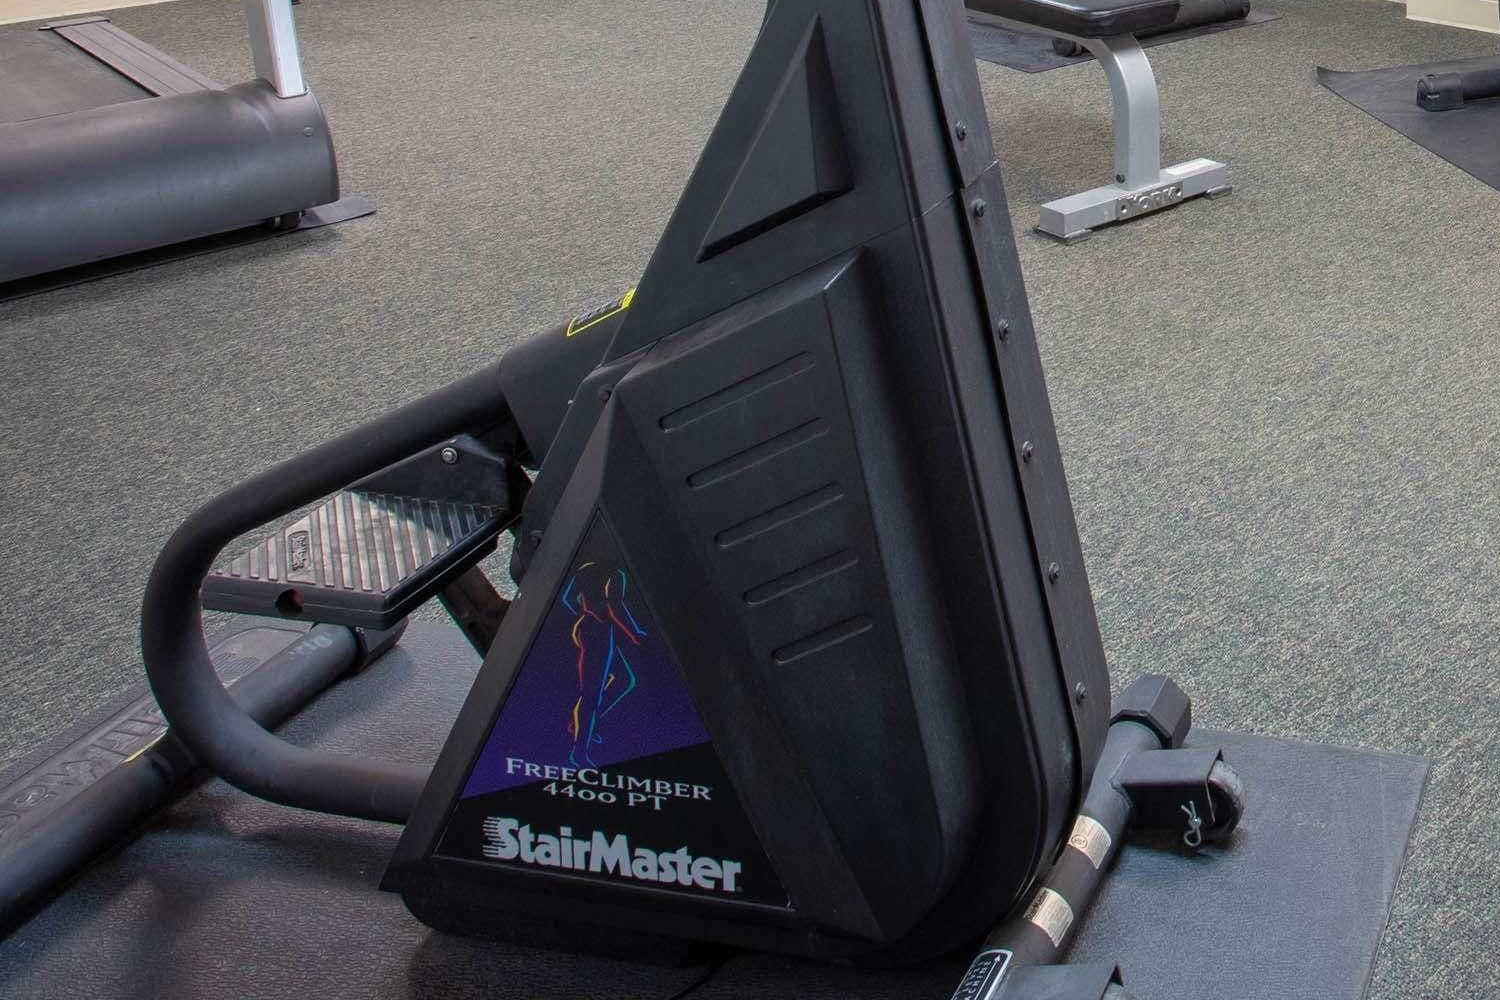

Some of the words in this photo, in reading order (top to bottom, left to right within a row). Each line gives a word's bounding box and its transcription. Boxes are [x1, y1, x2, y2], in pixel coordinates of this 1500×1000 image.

[543, 782, 617, 804] 4400
[628, 792, 667, 811] PT
[483, 816, 742, 892] StairMaster
